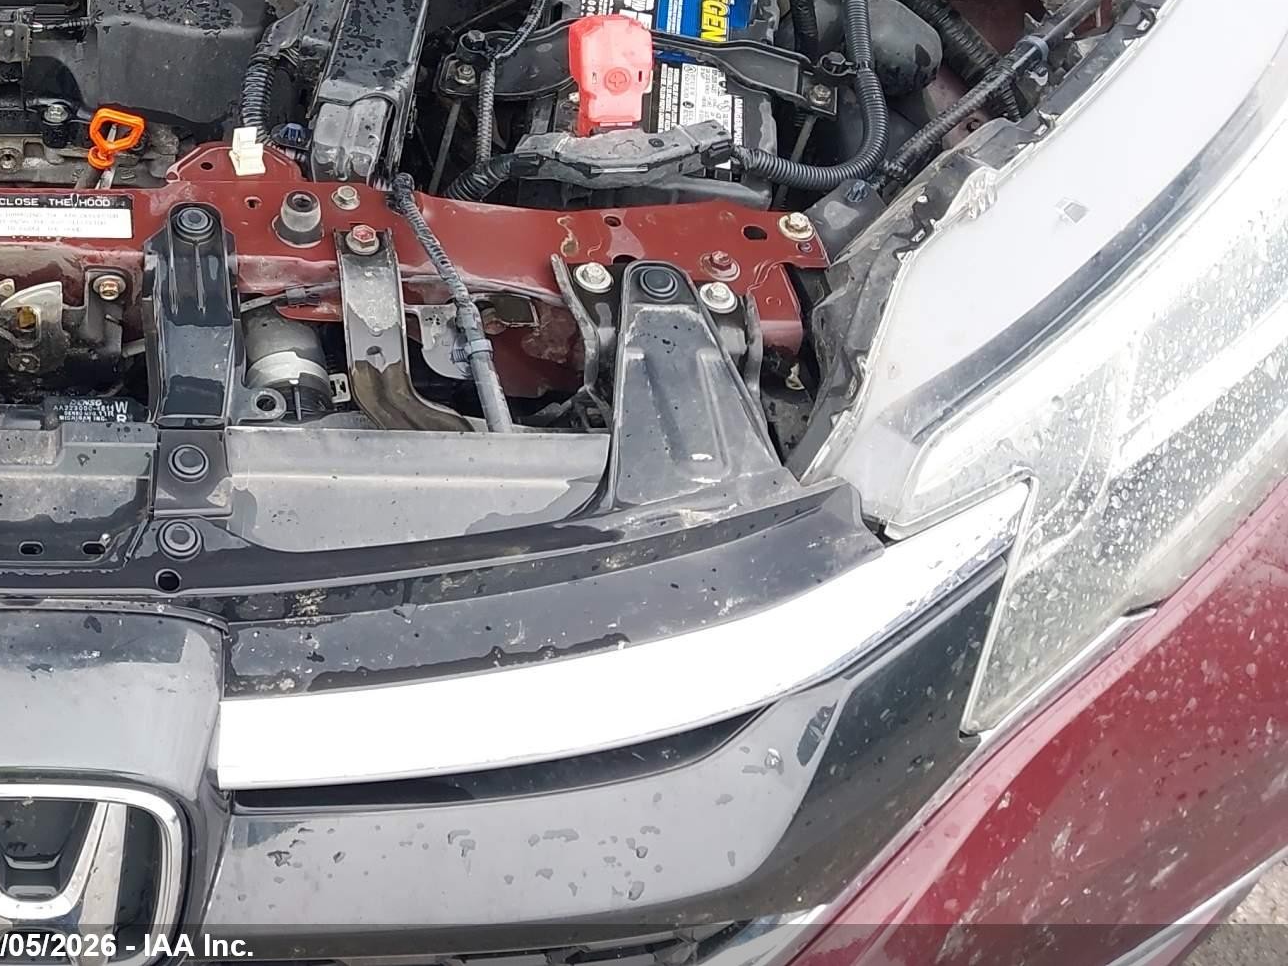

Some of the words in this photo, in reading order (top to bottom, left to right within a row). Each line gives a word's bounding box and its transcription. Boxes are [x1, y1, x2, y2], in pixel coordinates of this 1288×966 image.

[48, 198, 72, 207] THE
[80, 198, 111, 208] HOOD
[115, 401, 128, 414] W
[116, 414, 127, 423] R
